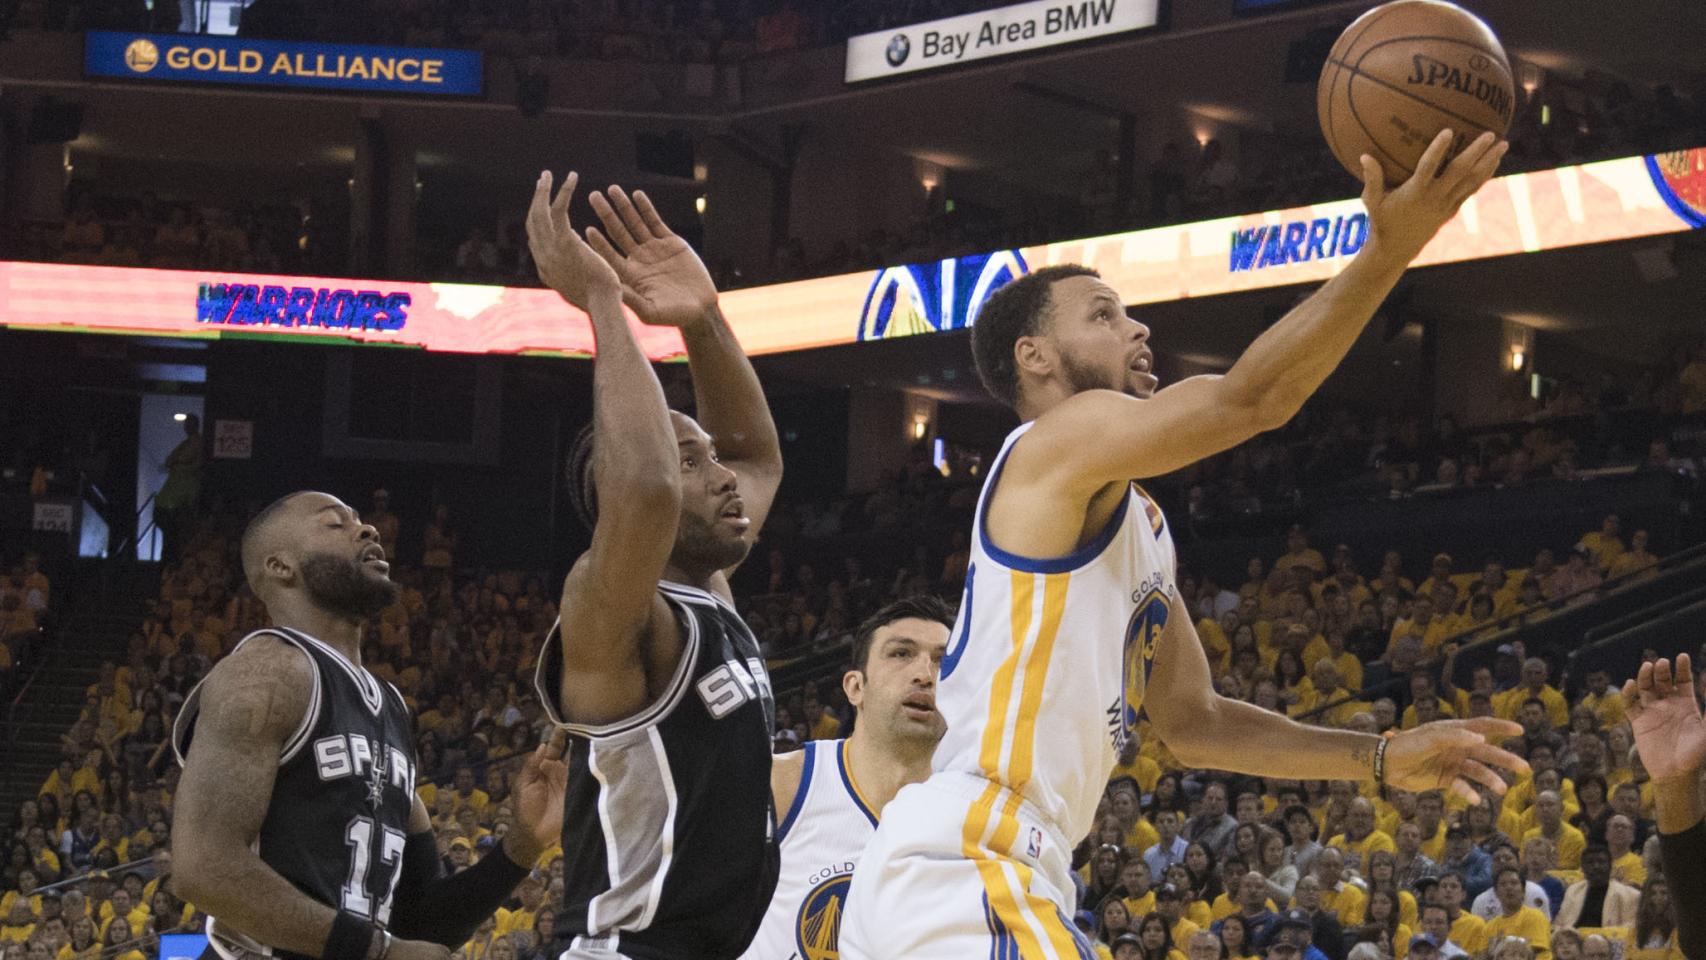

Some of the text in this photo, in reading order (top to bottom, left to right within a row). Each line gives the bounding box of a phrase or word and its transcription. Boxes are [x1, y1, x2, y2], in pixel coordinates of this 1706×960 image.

[923, 0, 1118, 58] Bay Area BMW
[165, 46, 444, 83] GOLD ALLIANCE
[1229, 212, 1369, 272] WARRIO
[196, 282, 411, 330] WARRIORS
[314, 733, 416, 803] SPUR
[341, 814, 406, 929] 17
[808, 861, 855, 885] GOLD
